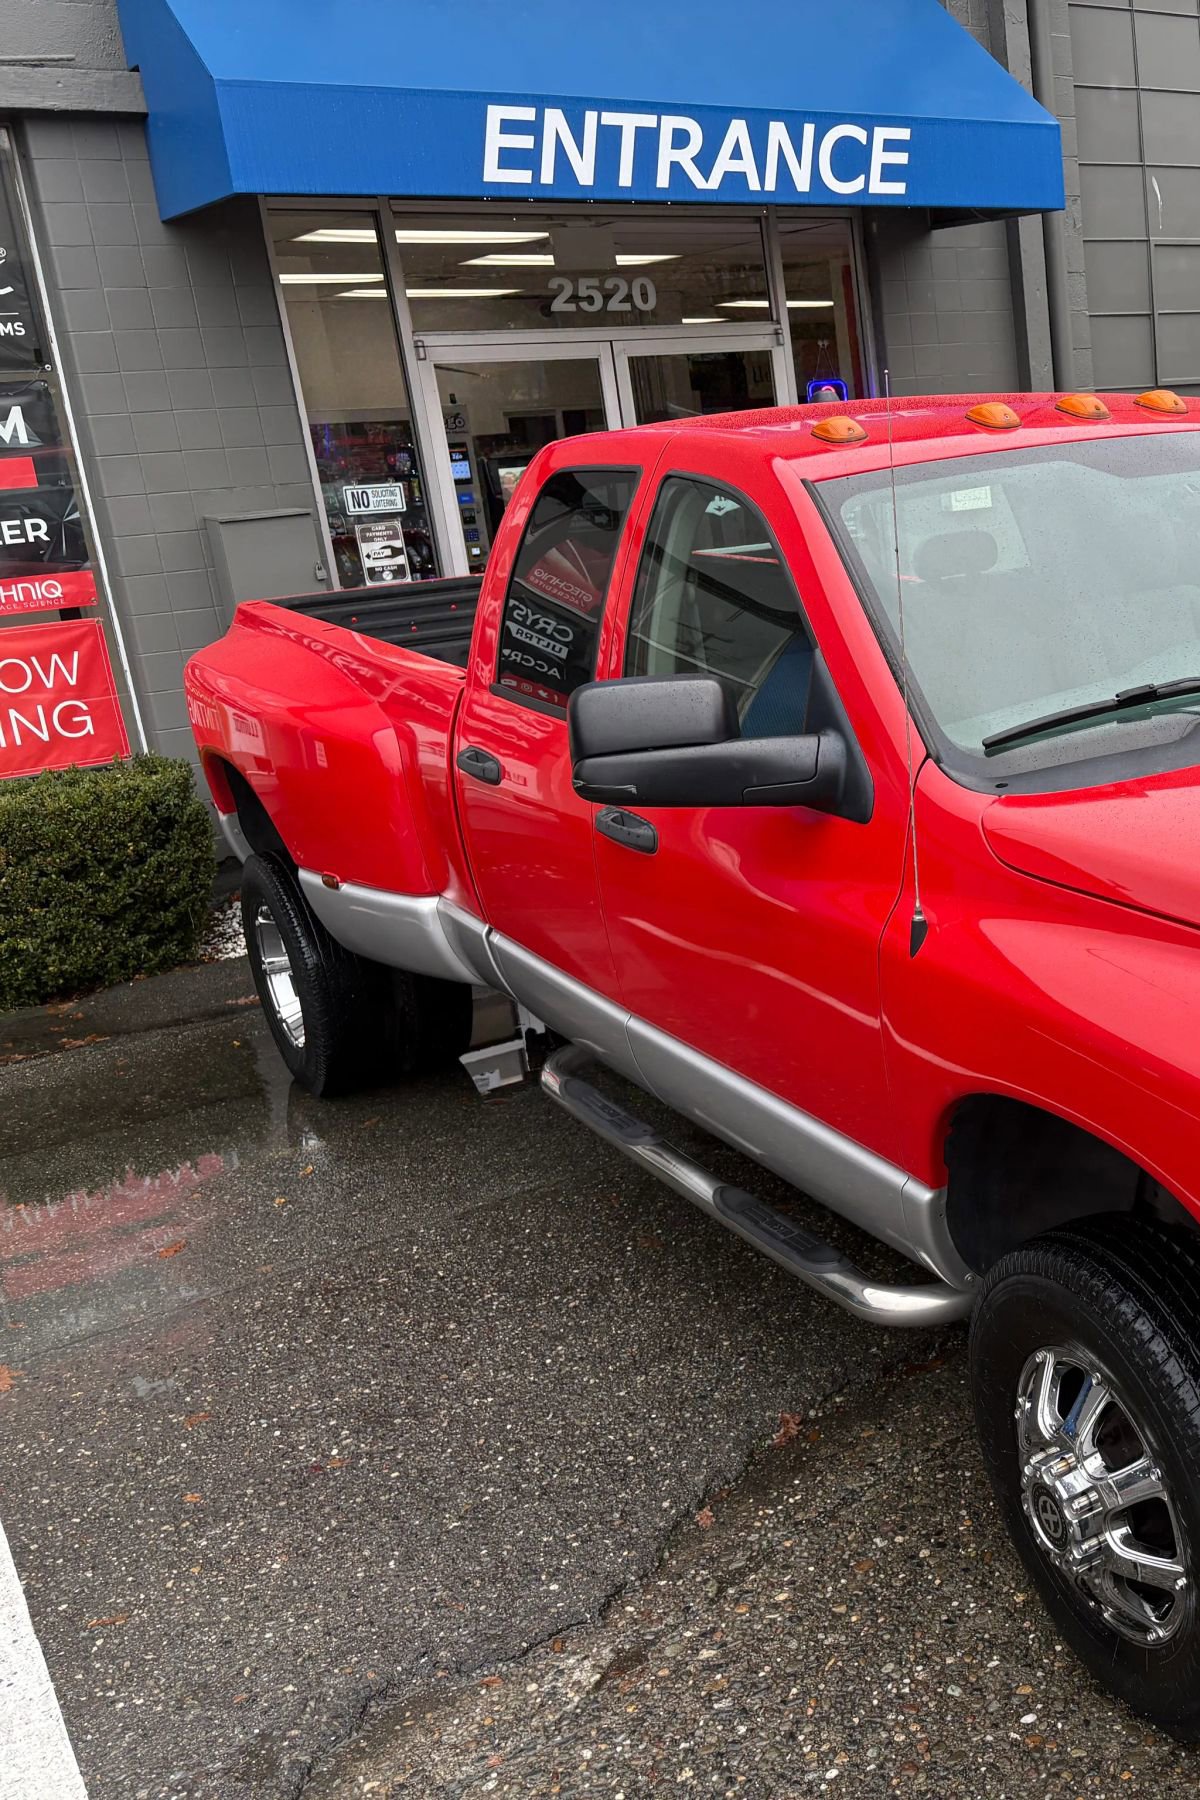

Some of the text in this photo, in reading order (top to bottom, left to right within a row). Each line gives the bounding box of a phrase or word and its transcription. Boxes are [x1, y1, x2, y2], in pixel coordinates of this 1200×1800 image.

[483, 104, 911, 194] ENTRANCE
[547, 276, 657, 312] 2520
[350, 490, 370, 510] NO
[371, 488, 398, 499] SOLICITING
[373, 499, 398, 509] LOITERING
[0, 518, 50, 546] ER
